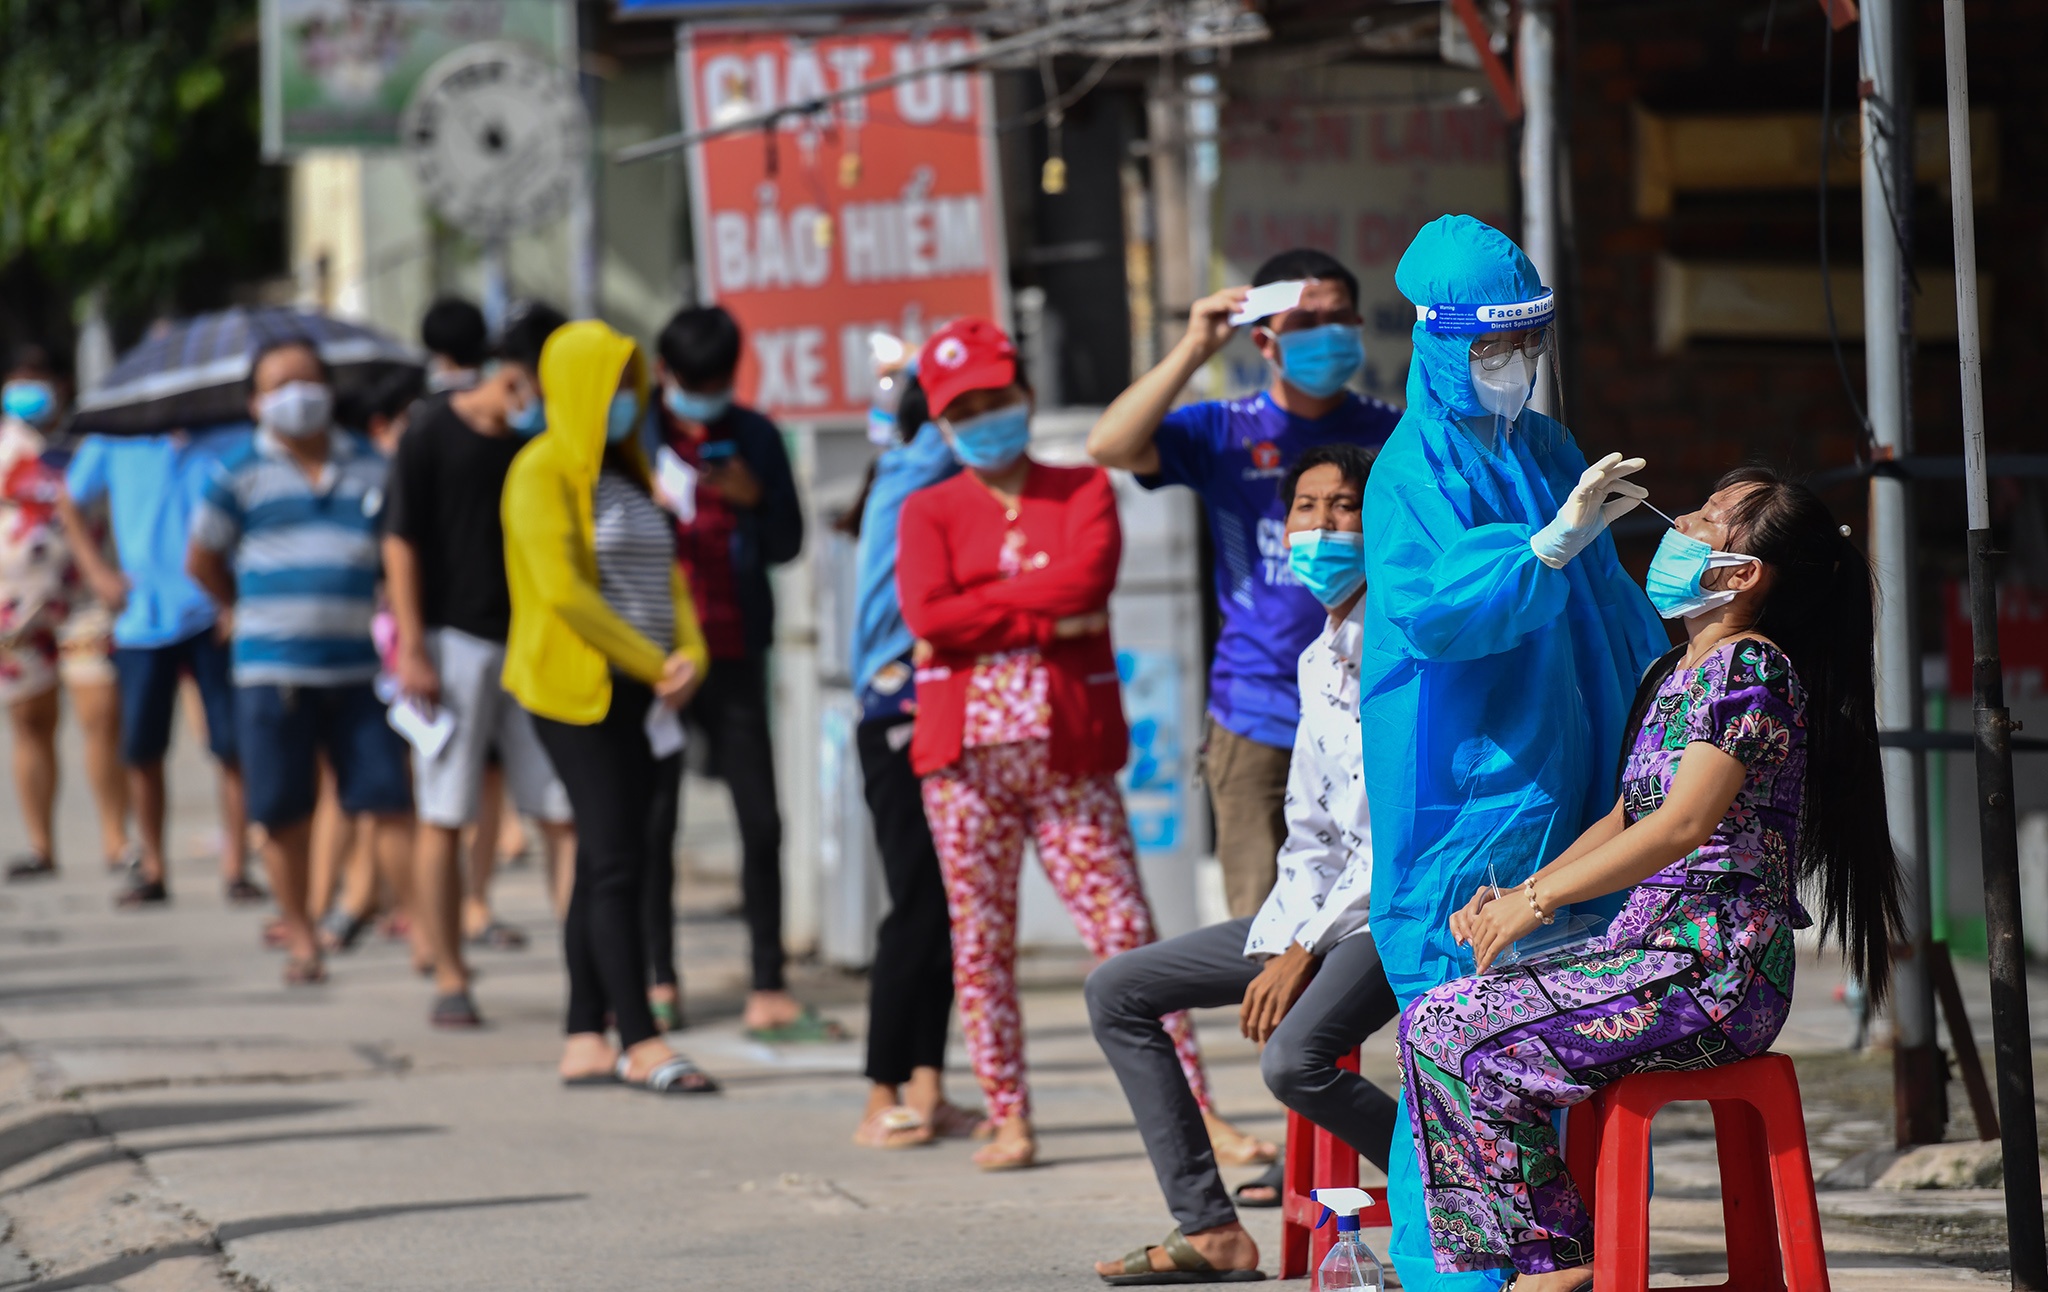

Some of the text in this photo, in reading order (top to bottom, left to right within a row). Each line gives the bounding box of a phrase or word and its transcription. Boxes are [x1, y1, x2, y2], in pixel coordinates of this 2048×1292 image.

[711, 183, 831, 292] BẢO
[1488, 308, 1523, 318] Face
[1513, 319, 1534, 328] Splash
[752, 324, 829, 407] XE
